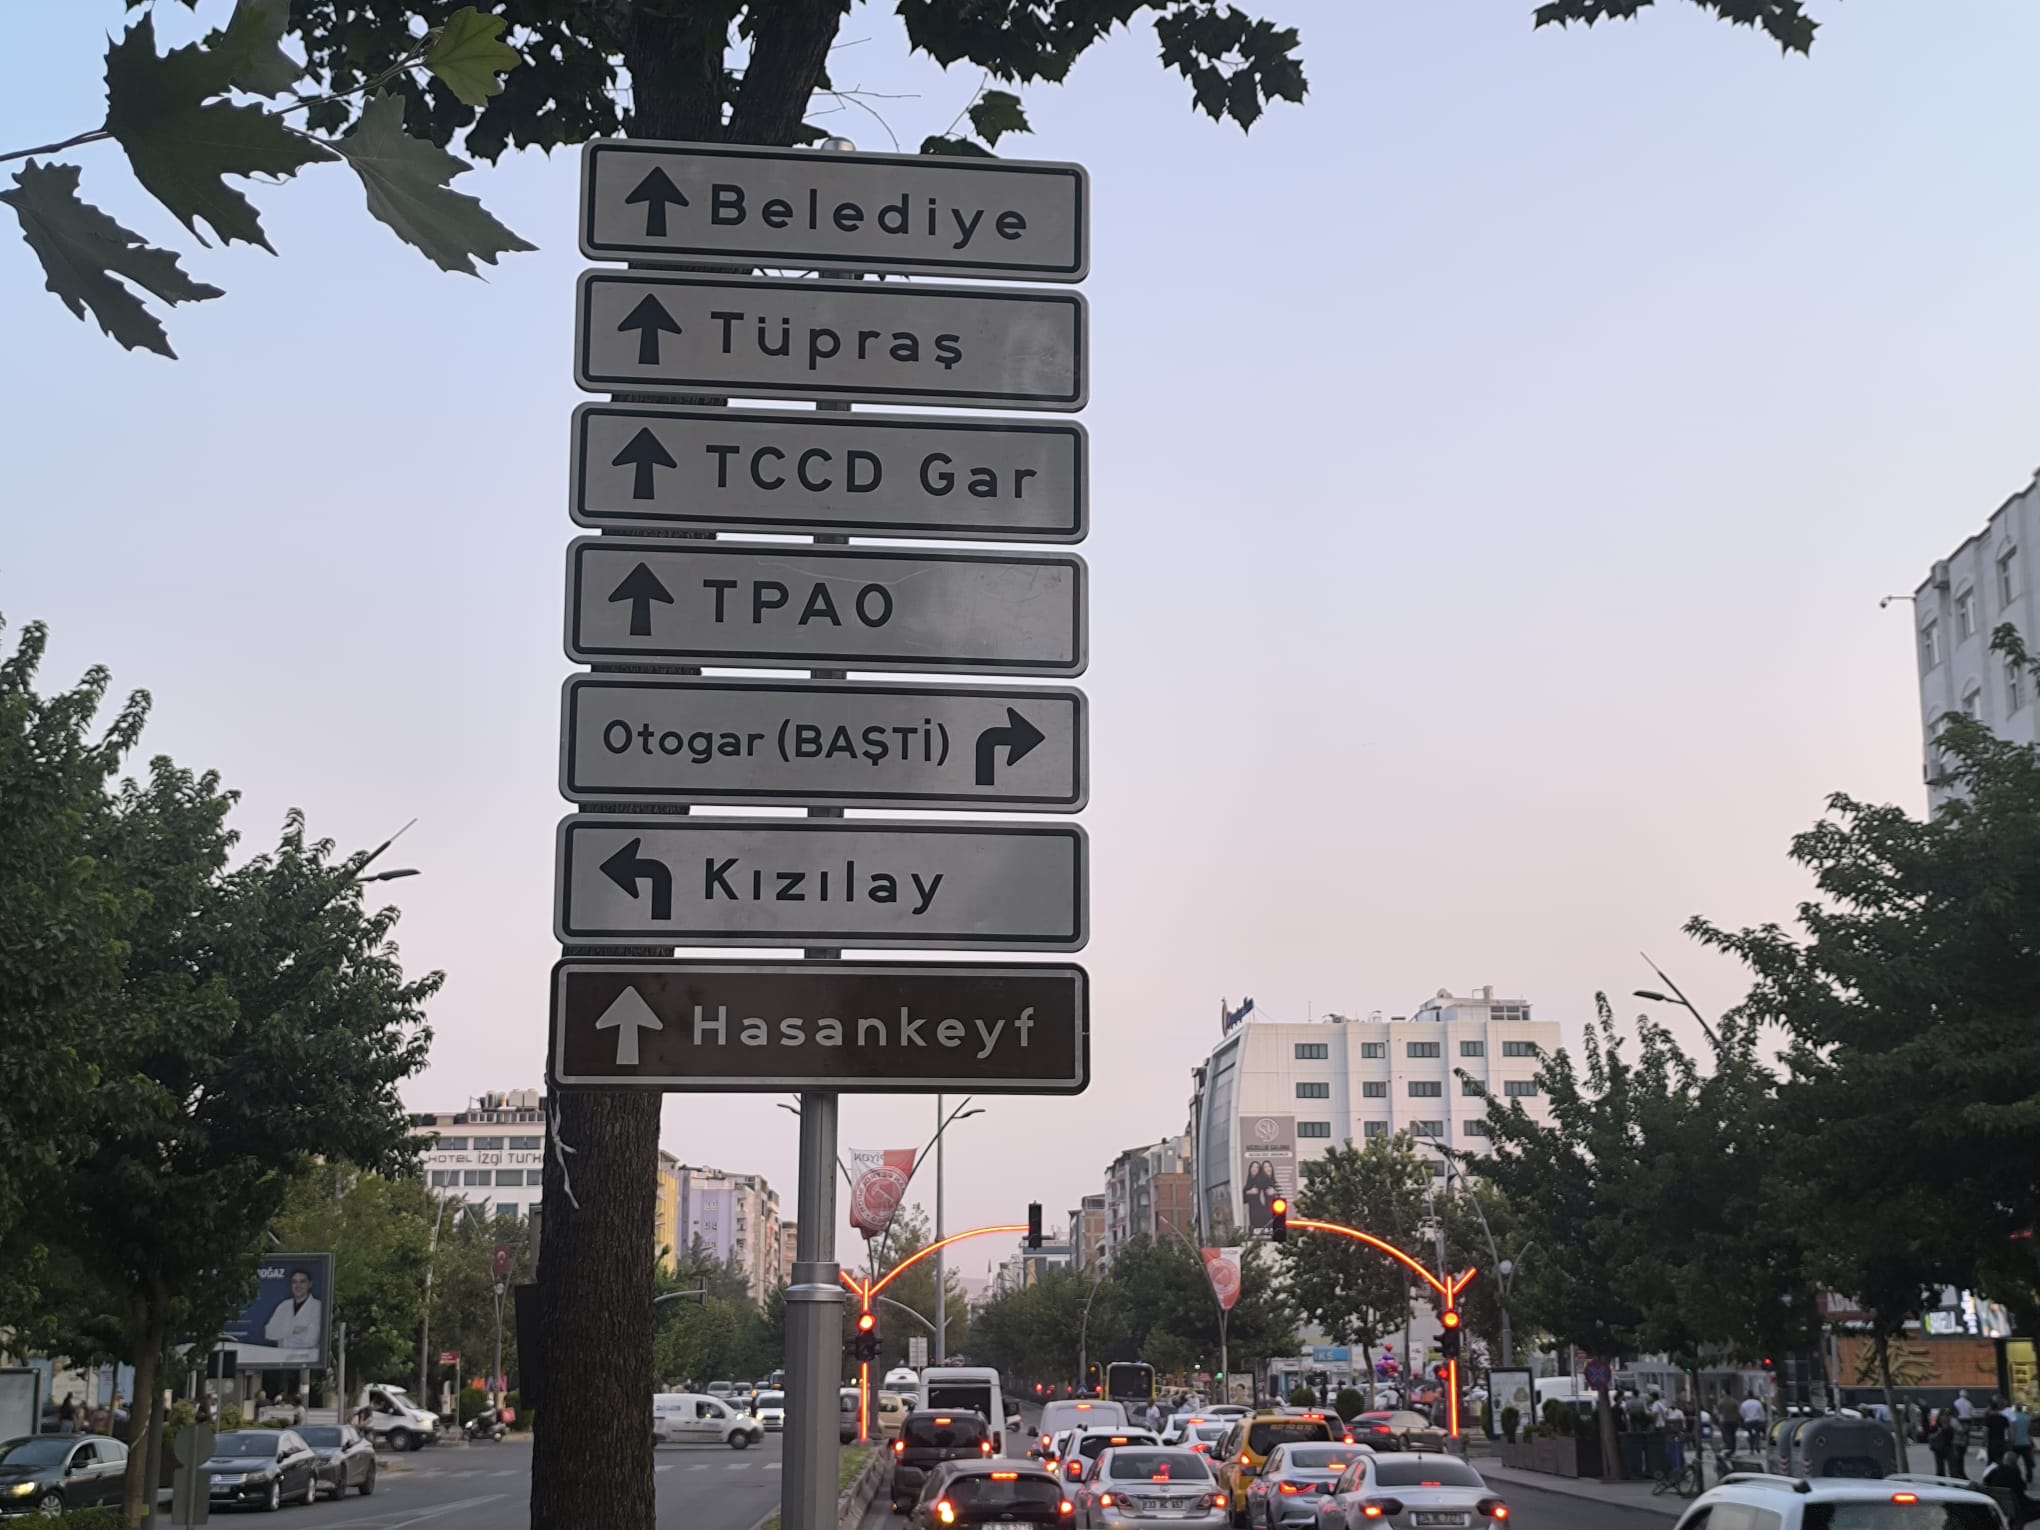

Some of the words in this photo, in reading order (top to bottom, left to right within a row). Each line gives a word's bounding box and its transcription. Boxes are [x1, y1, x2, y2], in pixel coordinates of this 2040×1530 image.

[710, 183, 1027, 250] Belediye
[710, 310, 963, 371] Tüpraş
[705, 444, 883, 493] TCCD
[919, 452, 1038, 499] Gar
[702, 578, 893, 628] TPAO
[603, 719, 766, 765] Otogar
[777, 717, 949, 767] (BAŞTİ)
[704, 857, 944, 915] Kızılay
[693, 1005, 1034, 1059] Hasankeyf
[428, 1154, 473, 1163] HOTEL
